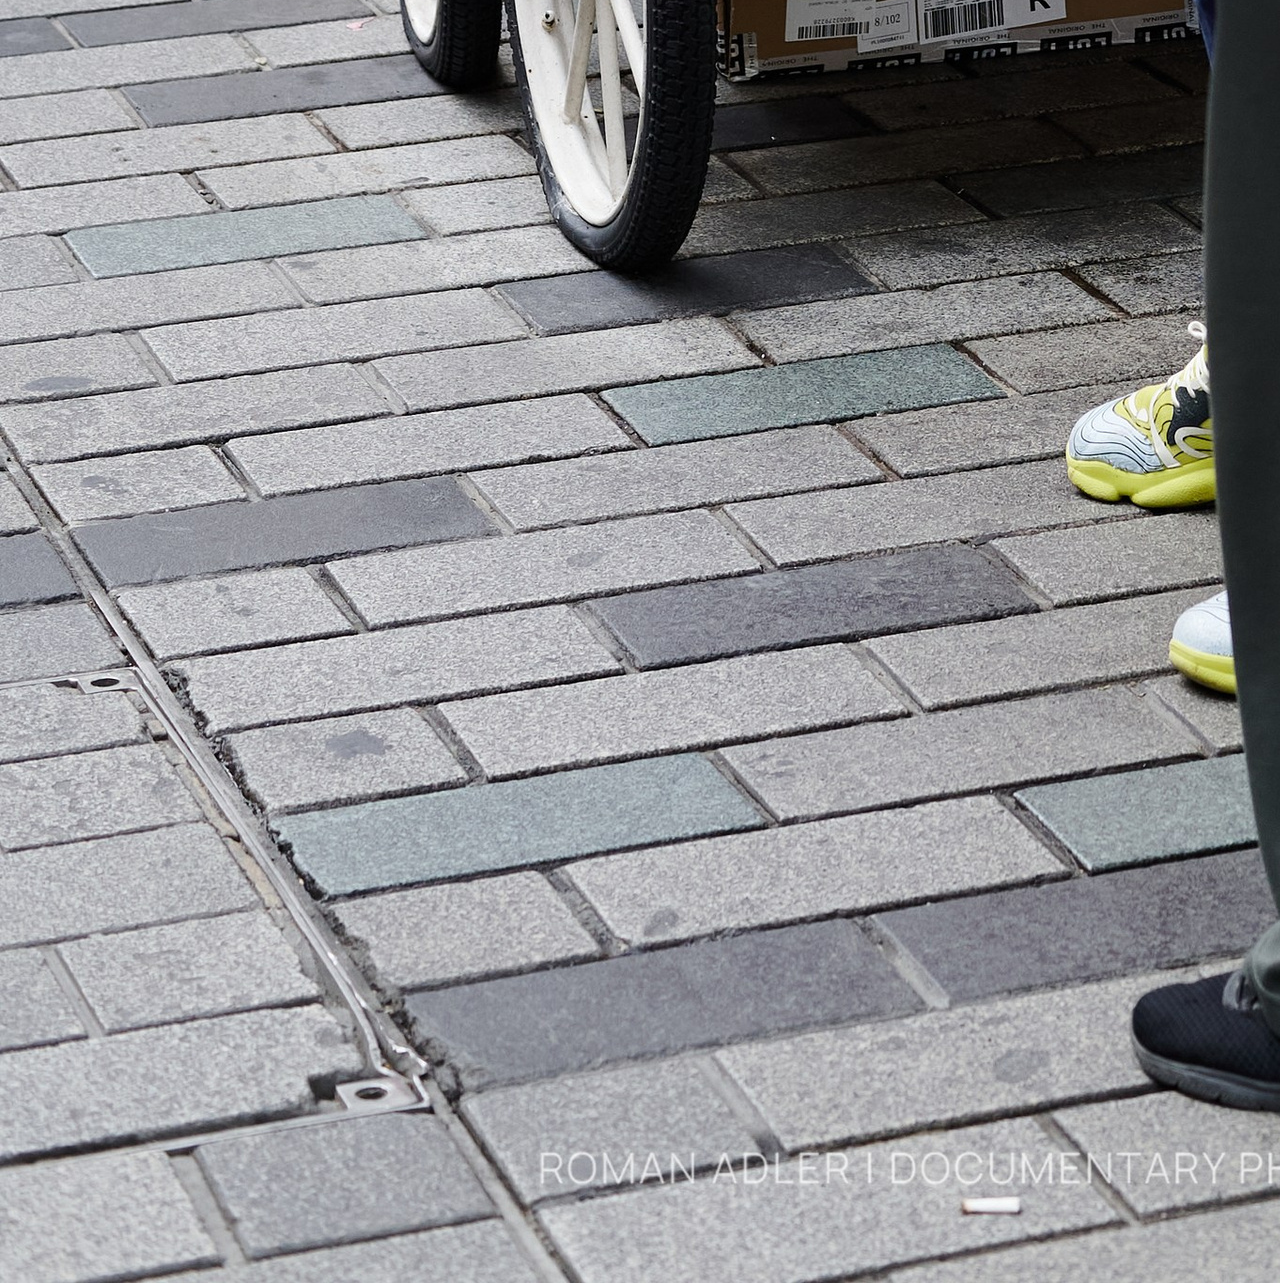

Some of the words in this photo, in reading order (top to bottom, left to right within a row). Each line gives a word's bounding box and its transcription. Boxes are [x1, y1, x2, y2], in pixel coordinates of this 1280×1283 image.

[874, 13, 901, 27] 8/102
[1142, 13, 1180, 23] ORIGINAL
[1048, 24, 1086, 34] ORIGINAL
[952, 36, 991, 45] ORIGINAL
